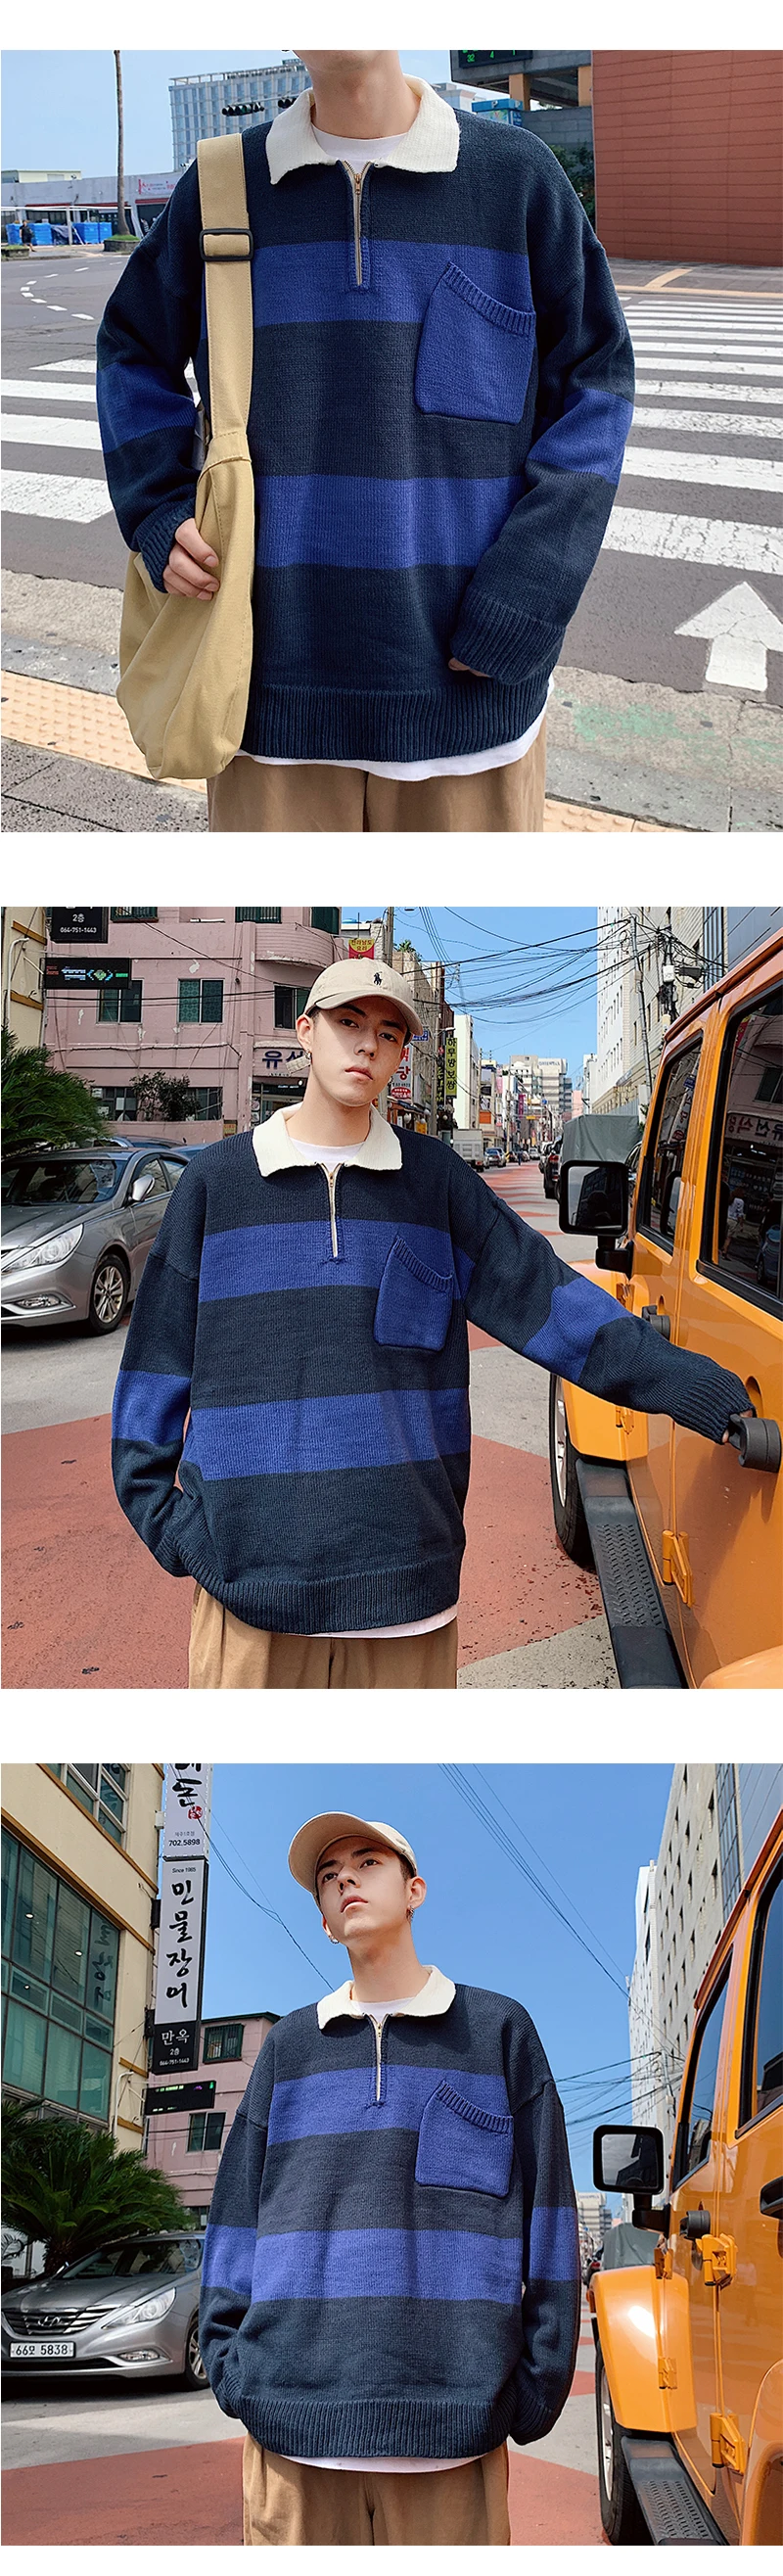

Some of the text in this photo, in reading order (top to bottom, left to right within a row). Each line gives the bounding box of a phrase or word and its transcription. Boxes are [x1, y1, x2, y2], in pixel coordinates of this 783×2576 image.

[72, 913, 85, 922] 2층
[165, 1879, 195, 2009] 민물장어
[161, 2029, 190, 2046] 만옥
[40, 2344, 69, 2356] 5838
